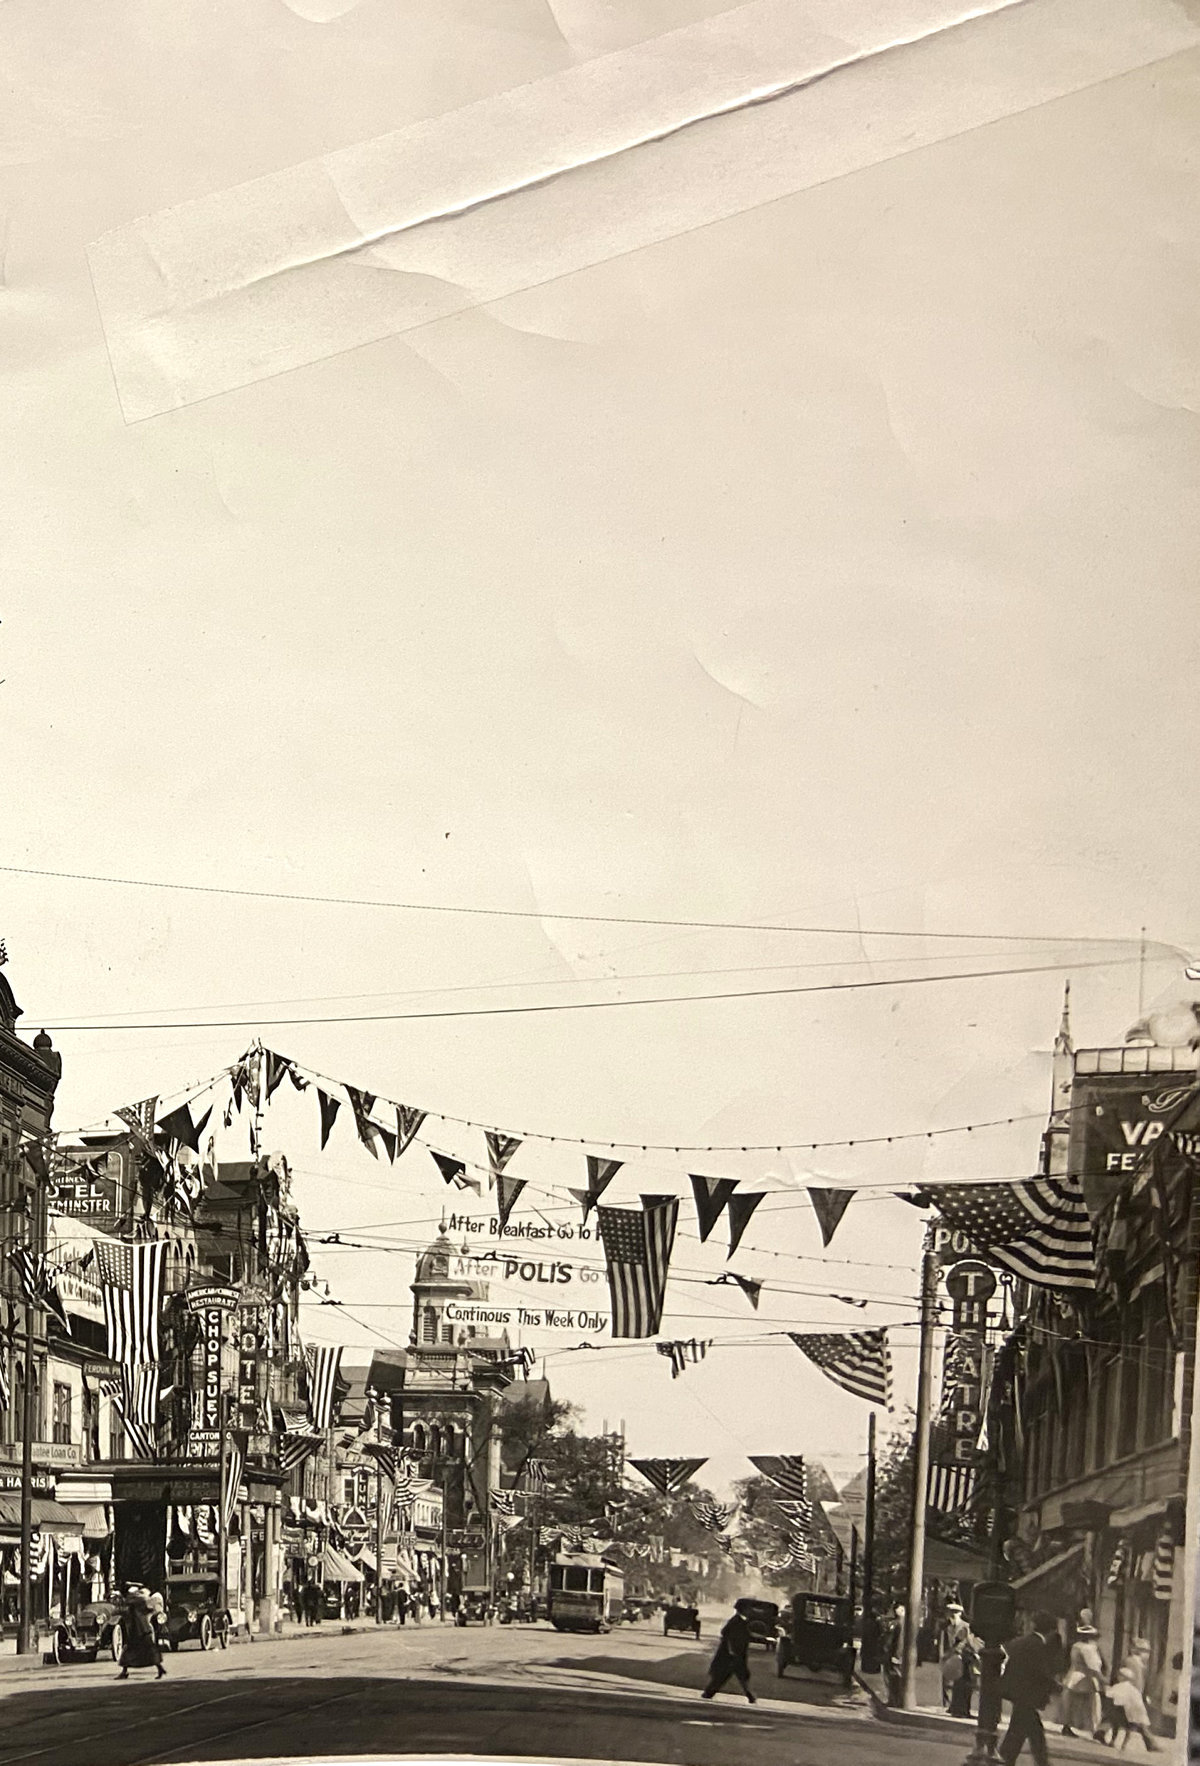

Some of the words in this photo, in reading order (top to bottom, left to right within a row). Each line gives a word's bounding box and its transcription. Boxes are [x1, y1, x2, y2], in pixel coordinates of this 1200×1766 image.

[449, 1213, 485, 1233] After
[490, 1217, 555, 1238] Beakfast
[577, 1223, 591, 1239] To
[454, 1258, 498, 1276] After
[505, 1260, 573, 1283] POLI'S
[580, 1266, 599, 1282] Go
[191, 1297, 237, 1309] RESTAURANT
[446, 1304, 511, 1323] Continous
[518, 1308, 541, 1325] This
[546, 1310, 574, 1328] Week
[578, 1311, 608, 1333] Only
[207, 1311, 220, 1367] CHOP
[239, 1307, 258, 1430] HOTEL
[205, 1370, 219, 1426] SUEY
[6, 1476, 46, 1488] HARIS
